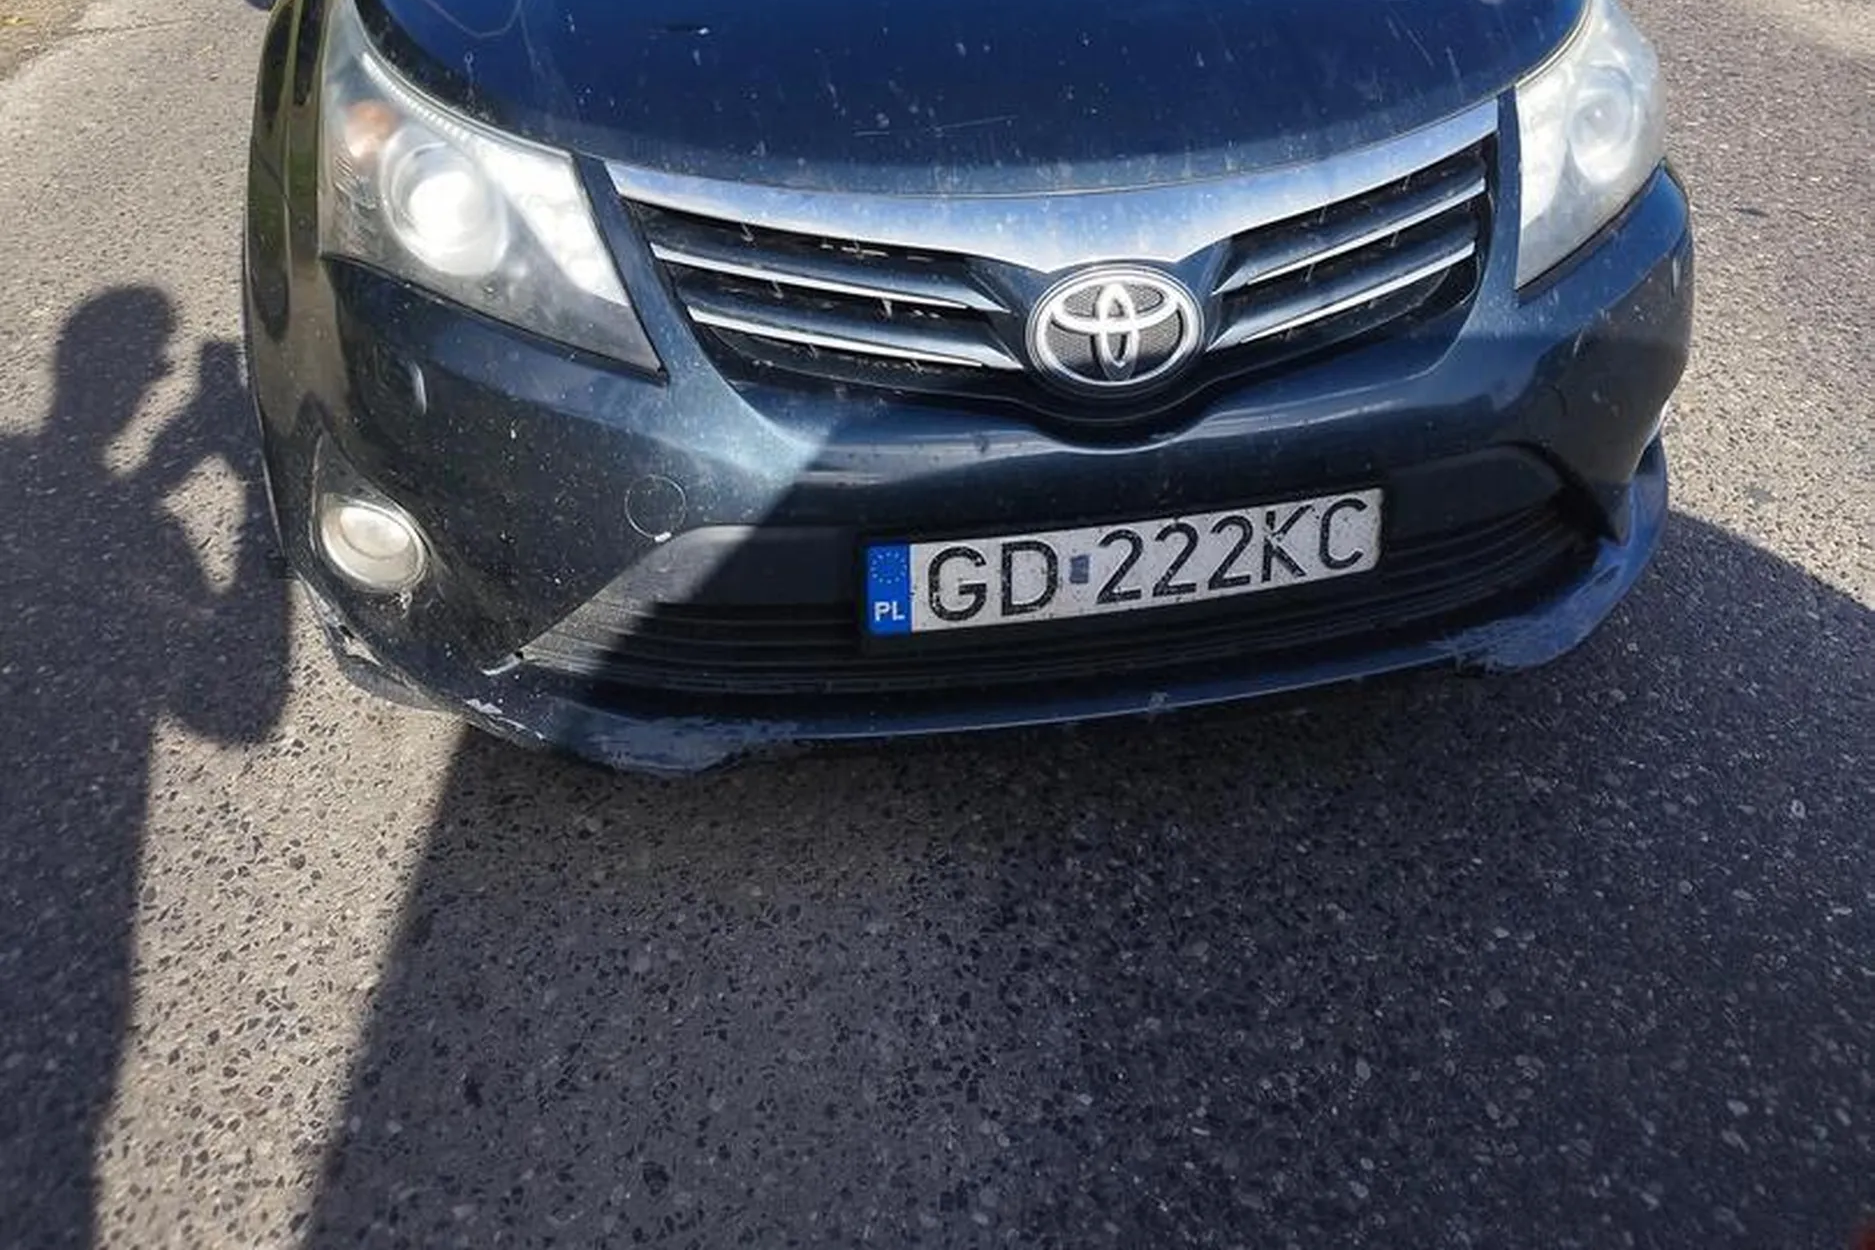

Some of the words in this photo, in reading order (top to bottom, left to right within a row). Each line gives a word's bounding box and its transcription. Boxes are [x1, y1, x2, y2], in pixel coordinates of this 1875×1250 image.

[927, 540, 1058, 621] GD
[1096, 498, 1368, 605] 222KC
[874, 602, 905, 621] PL
